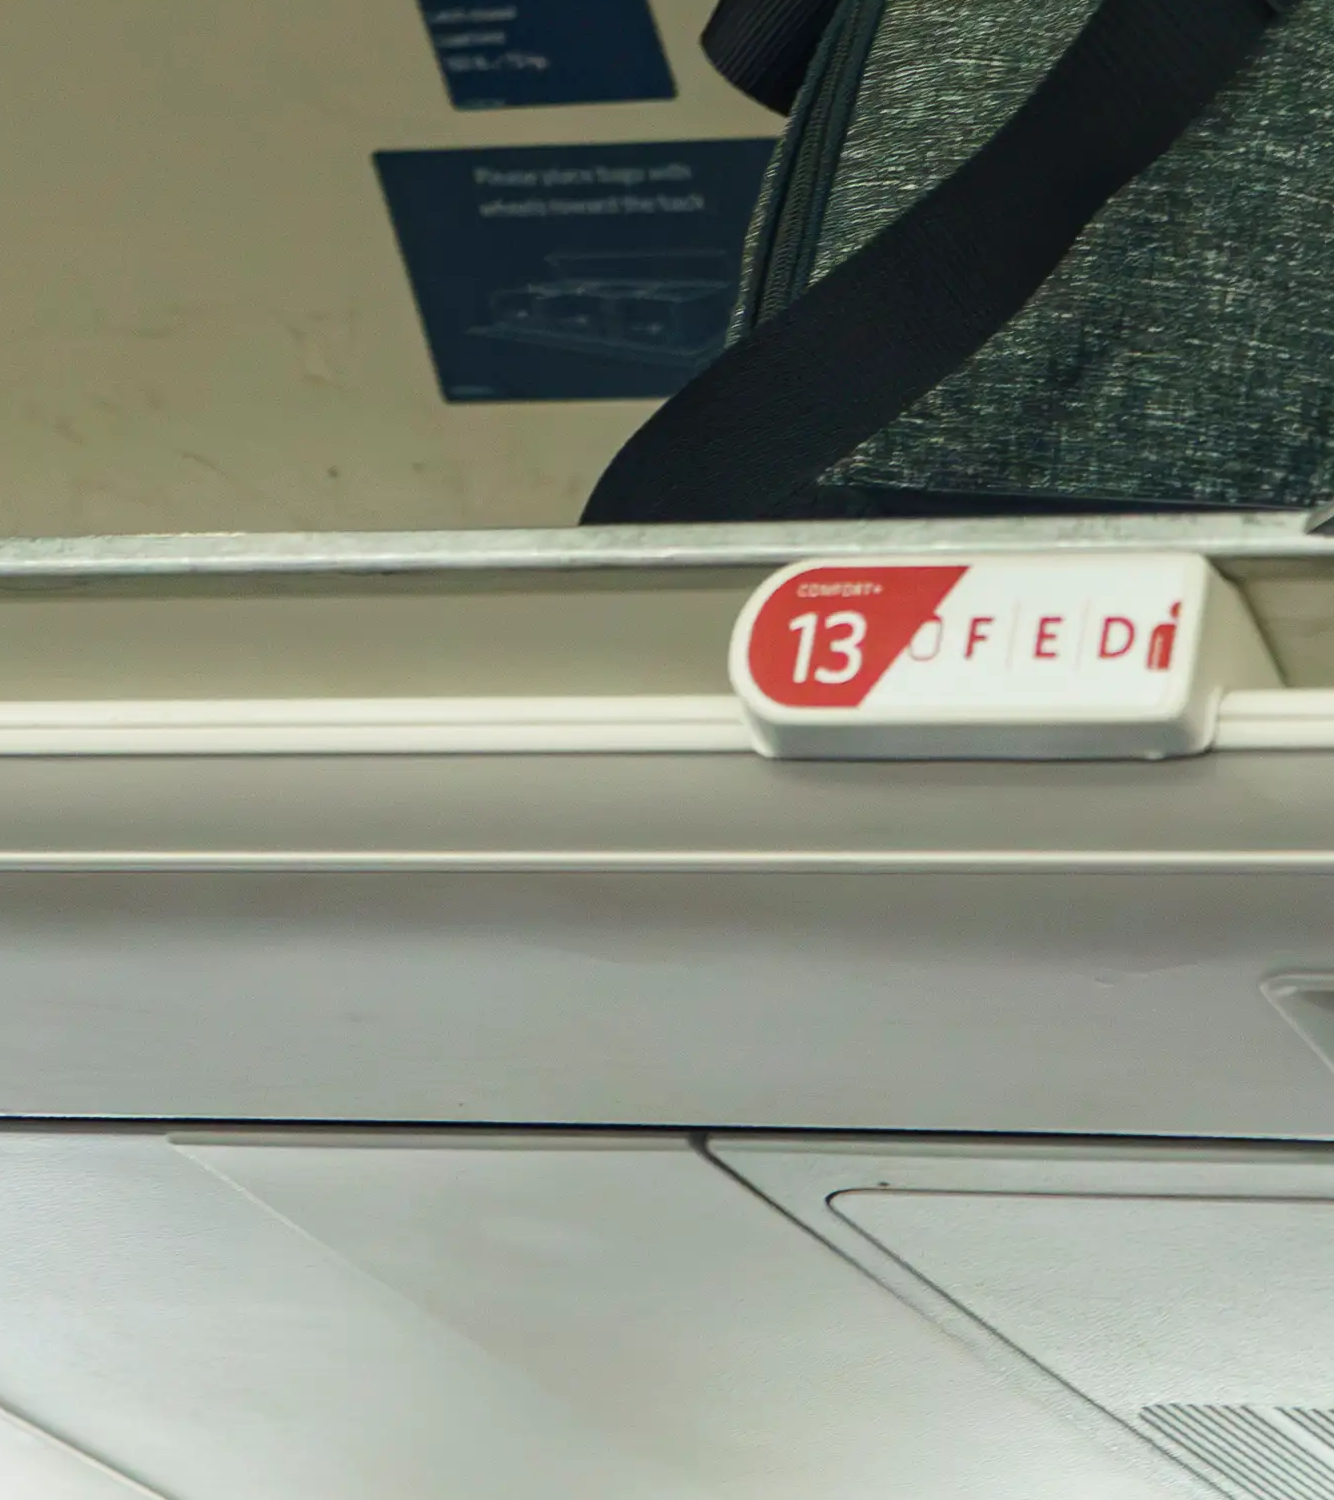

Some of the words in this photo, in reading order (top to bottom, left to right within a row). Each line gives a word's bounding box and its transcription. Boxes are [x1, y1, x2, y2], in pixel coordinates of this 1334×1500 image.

[787, 610, 869, 685] 13
[965, 617, 993, 658] F
[1034, 617, 1063, 658] E
[1098, 617, 1135, 658] D
